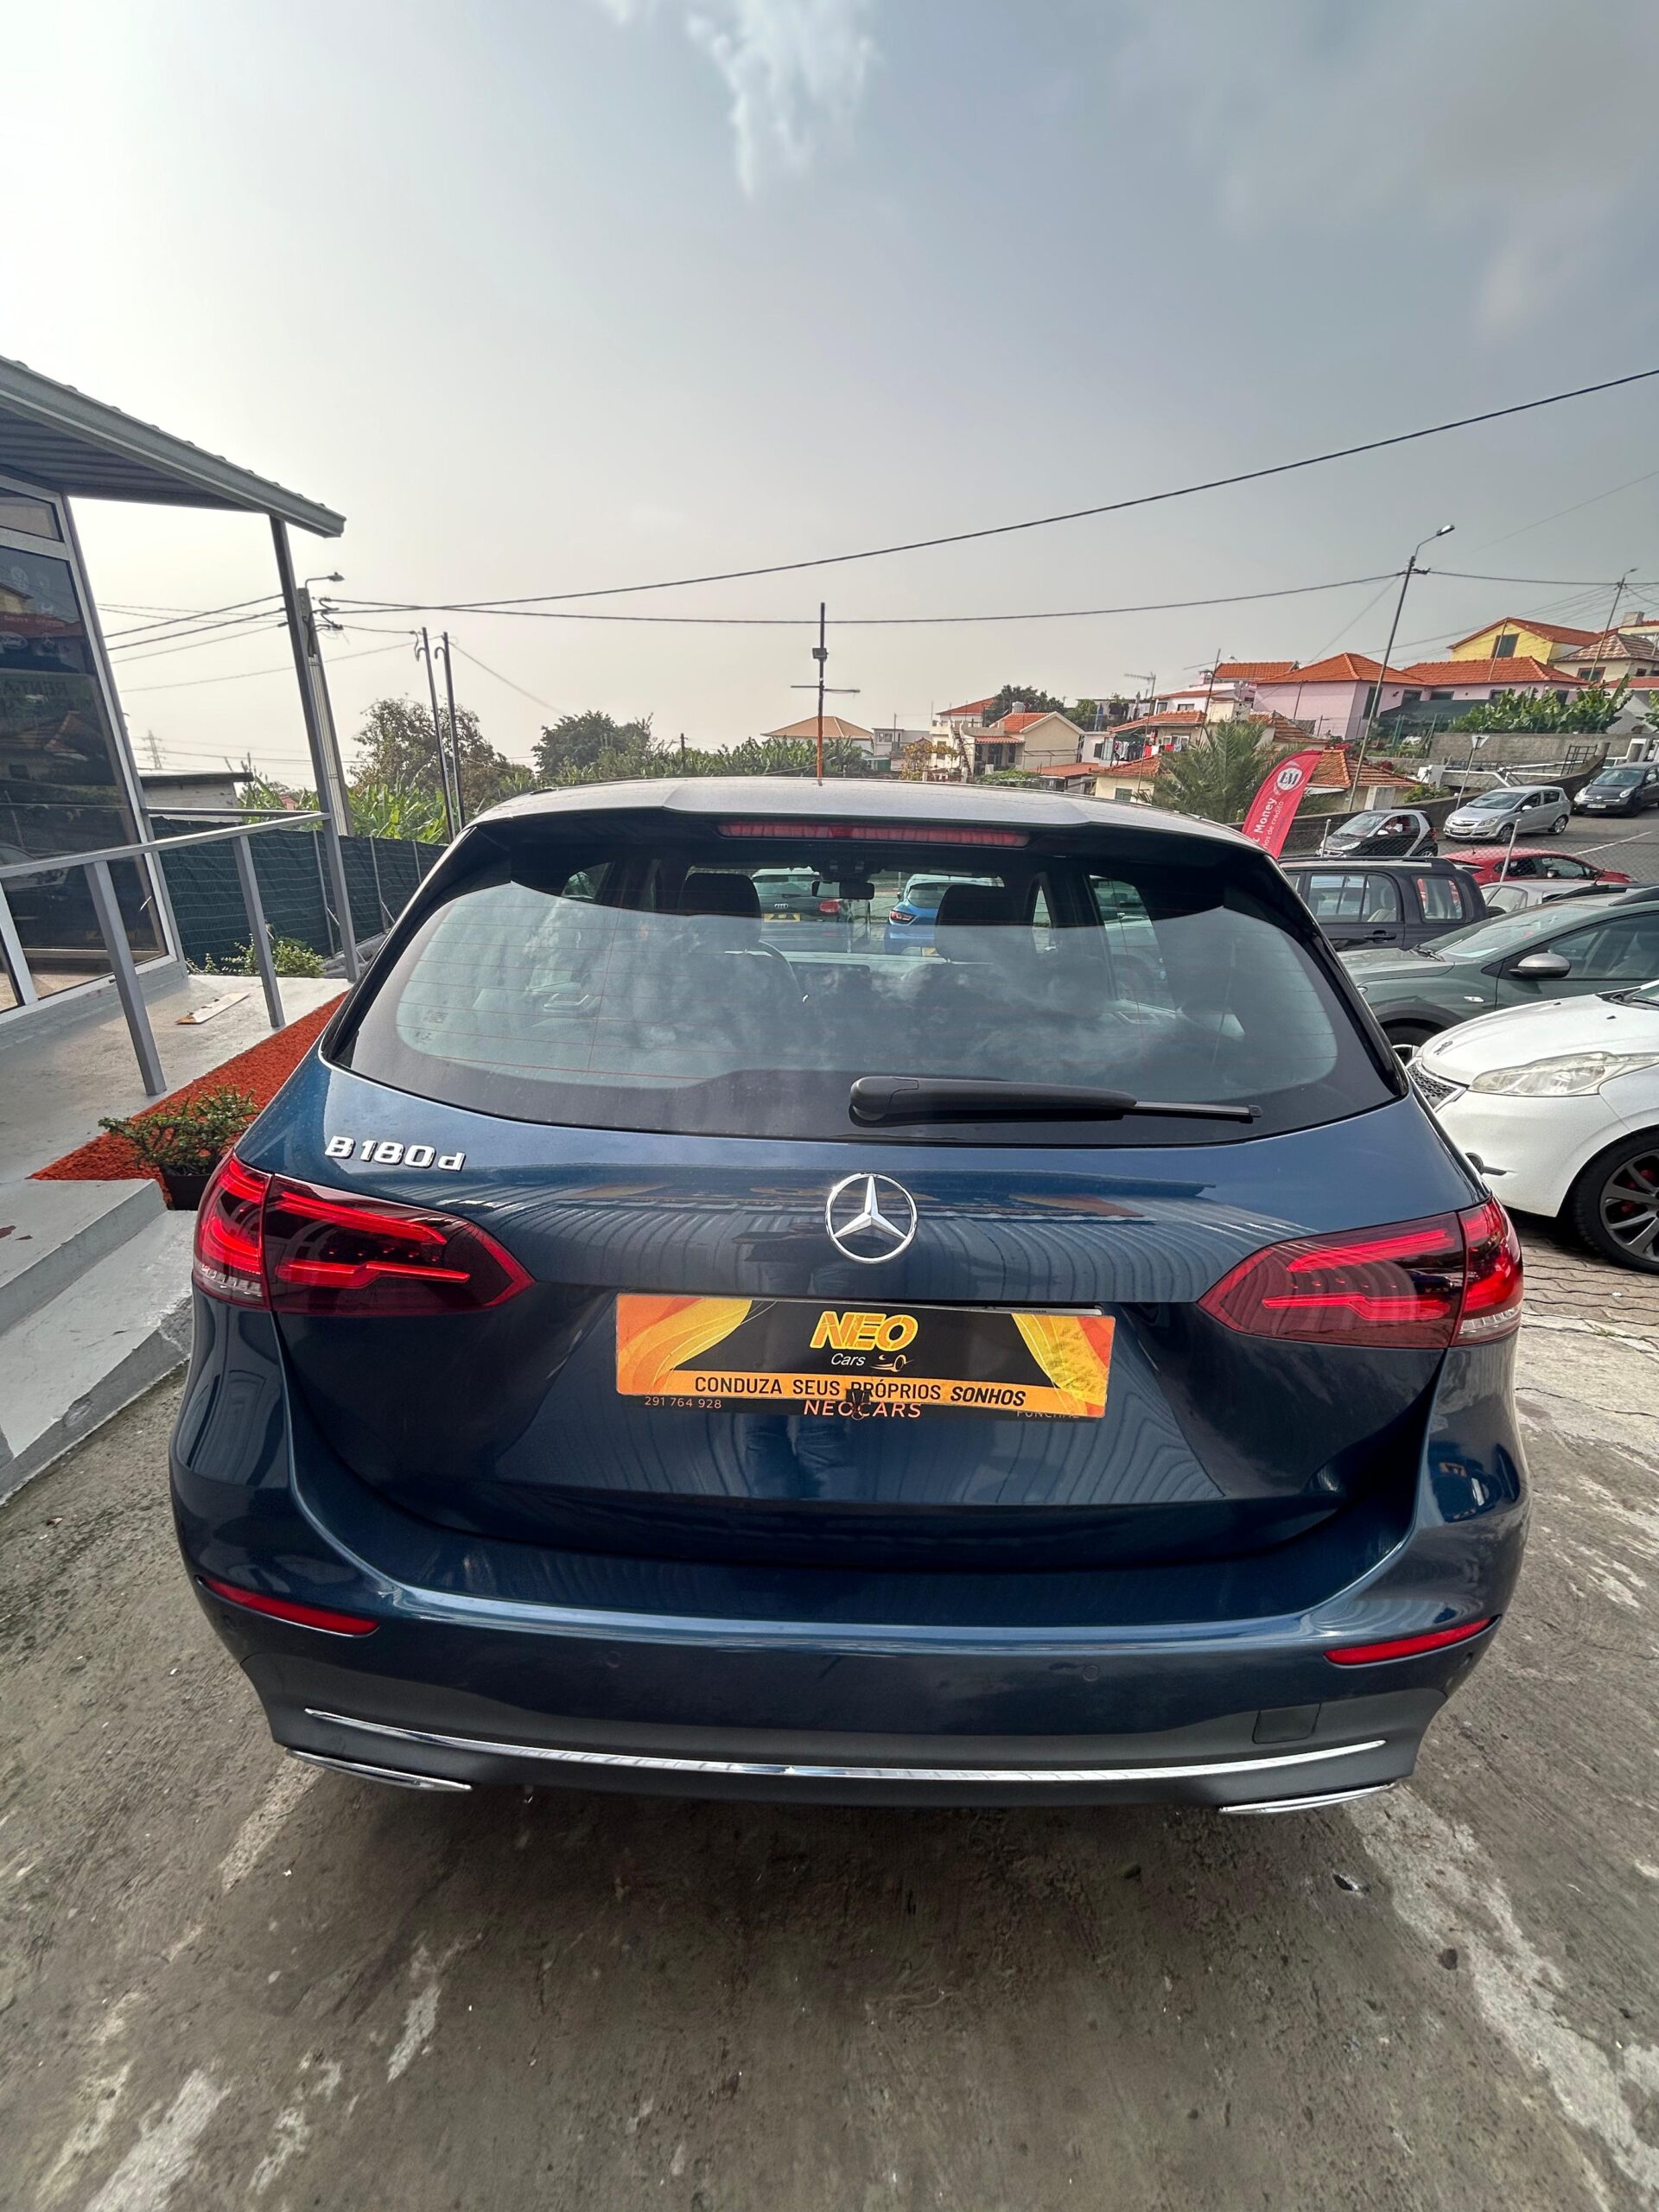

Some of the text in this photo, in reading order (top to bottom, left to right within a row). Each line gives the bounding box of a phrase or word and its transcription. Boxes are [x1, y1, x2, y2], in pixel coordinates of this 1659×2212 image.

[1254, 798, 1277, 833] Money
[810, 1311, 918, 1351] NEO
[830, 1352, 866, 1366] Cars
[645, 1396, 721, 1409] 291 764 928
[695, 1376, 782, 1394] CONDUZA
[792, 1379, 841, 1396] SEUS
[950, 1386, 1027, 1407] SONHOS
